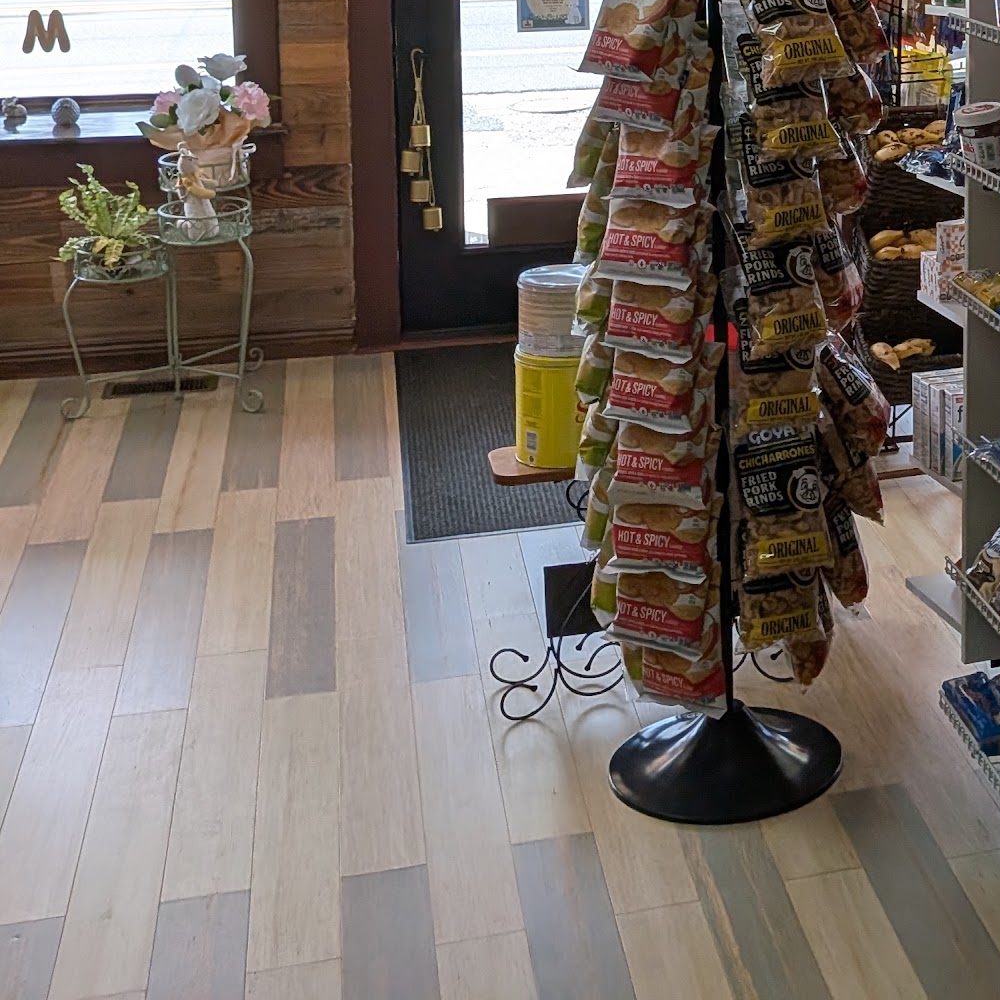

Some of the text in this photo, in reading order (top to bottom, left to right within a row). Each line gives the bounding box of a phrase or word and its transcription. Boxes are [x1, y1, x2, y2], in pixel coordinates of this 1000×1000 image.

[603, 35, 623, 50] SPICY
[784, 37, 837, 60] ORIGINAL
[620, 81, 640, 96] SPICY
[779, 122, 830, 144] ORIGINAL
[636, 160, 658, 174] SPICY
[748, 160, 785, 177] RINDS
[774, 203, 821, 227] ORIGINAL
[608, 232, 623, 247] HOT
[632, 233, 656, 248] SPICY
[742, 249, 775, 264] FRIED
[744, 259, 778, 275] PORK
[746, 268, 785, 285] RINDS
[611, 303, 625, 320] HOT
[632, 310, 659, 326] SPICY
[773, 313, 822, 335] ORIGINAL
[631, 382, 657, 397] SPICY
[759, 398, 811, 417] ORIGINAL
[749, 424, 796, 445] GOYA
[639, 457, 663, 471] SPICY
[738, 445, 816, 470] CHICHARRONES
[741, 470, 777, 489] FRIED
[743, 480, 780, 497] PORK
[746, 490, 784, 508] RINDS
[618, 529, 635, 544] HOT
[643, 533, 670, 549] SPICY
[768, 535, 818, 558] ORIGINAL
[640, 607, 667, 624] SPICY
[761, 610, 811, 636] ORIGINAL
[662, 671, 684, 689] SPICY
